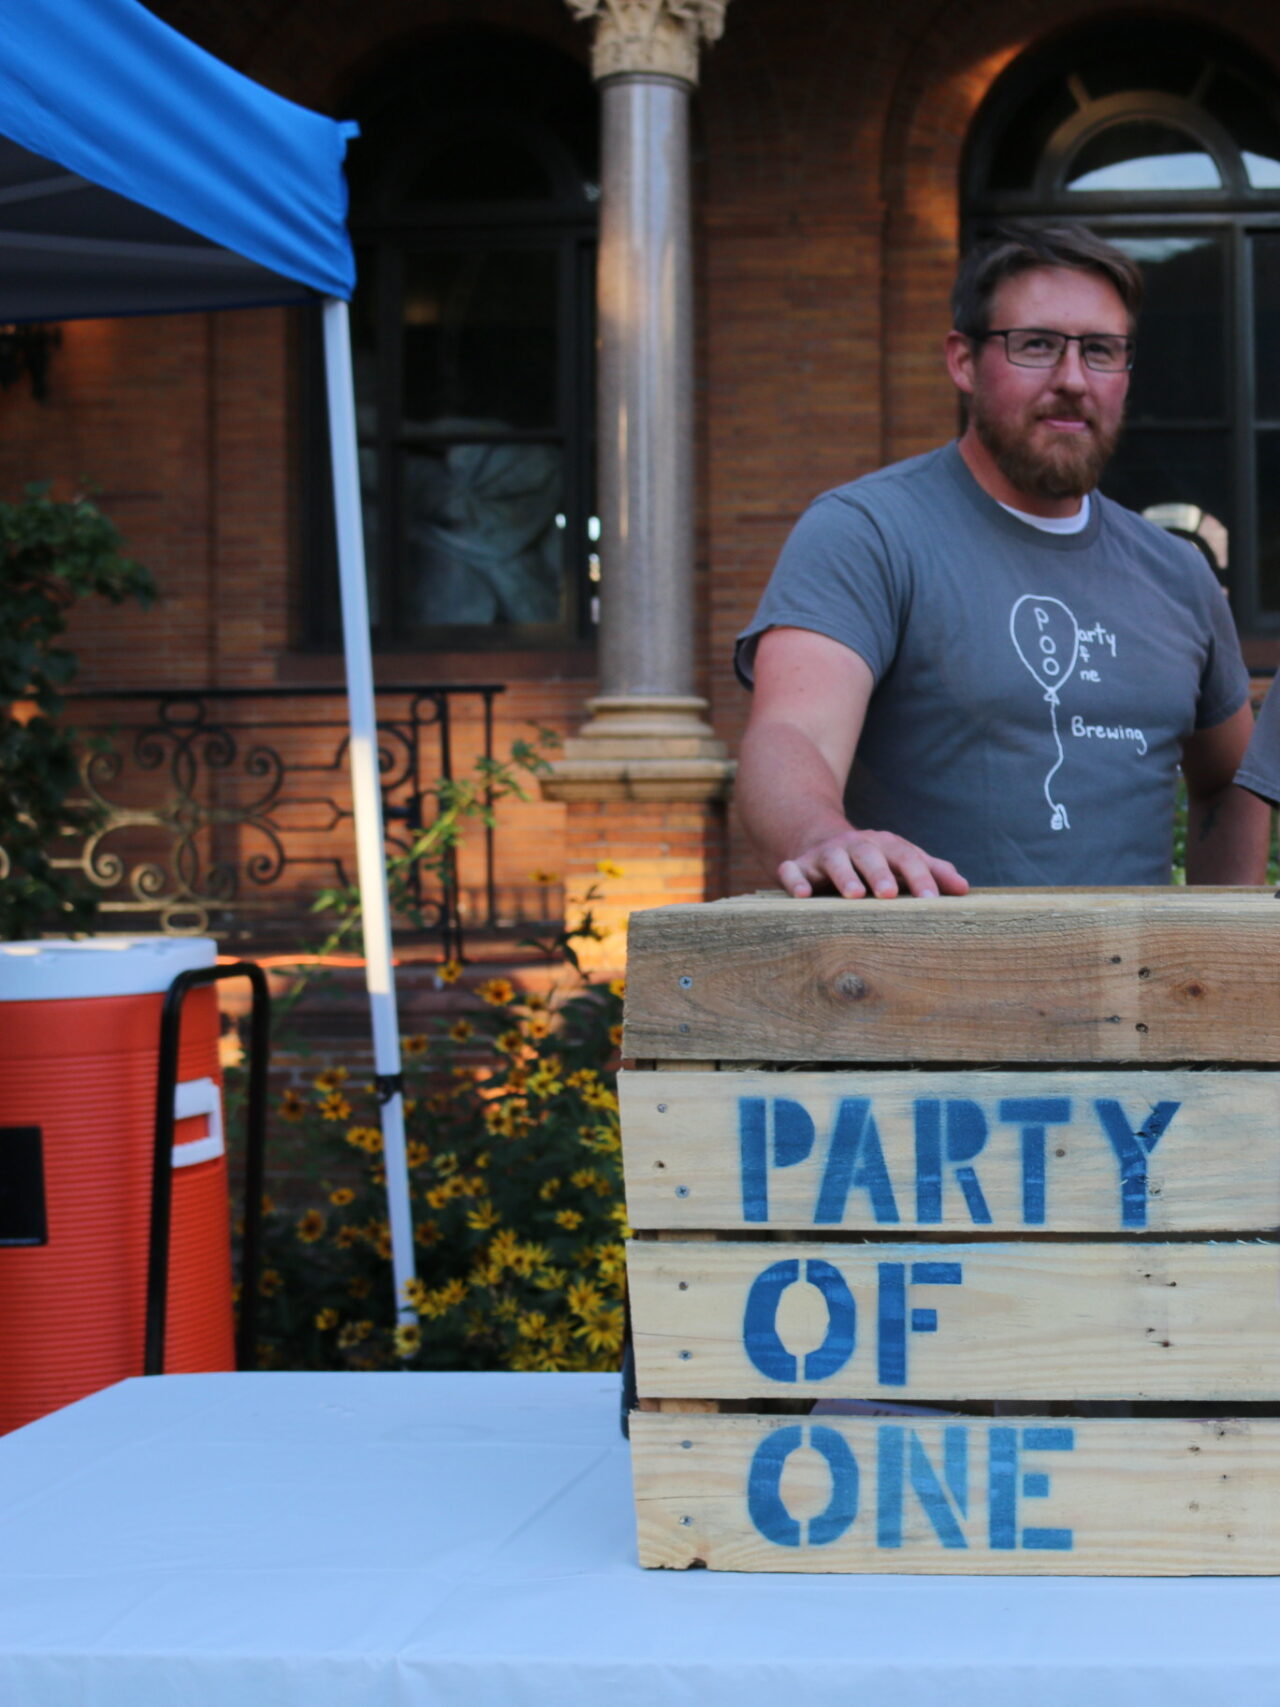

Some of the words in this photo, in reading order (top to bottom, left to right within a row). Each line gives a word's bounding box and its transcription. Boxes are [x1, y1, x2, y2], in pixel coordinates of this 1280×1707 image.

[1071, 715, 1148, 756] Brewing
[737, 1095, 1182, 1229] PARTY
[743, 1258, 963, 1386] OF
[747, 1424, 1076, 1550] ONE
